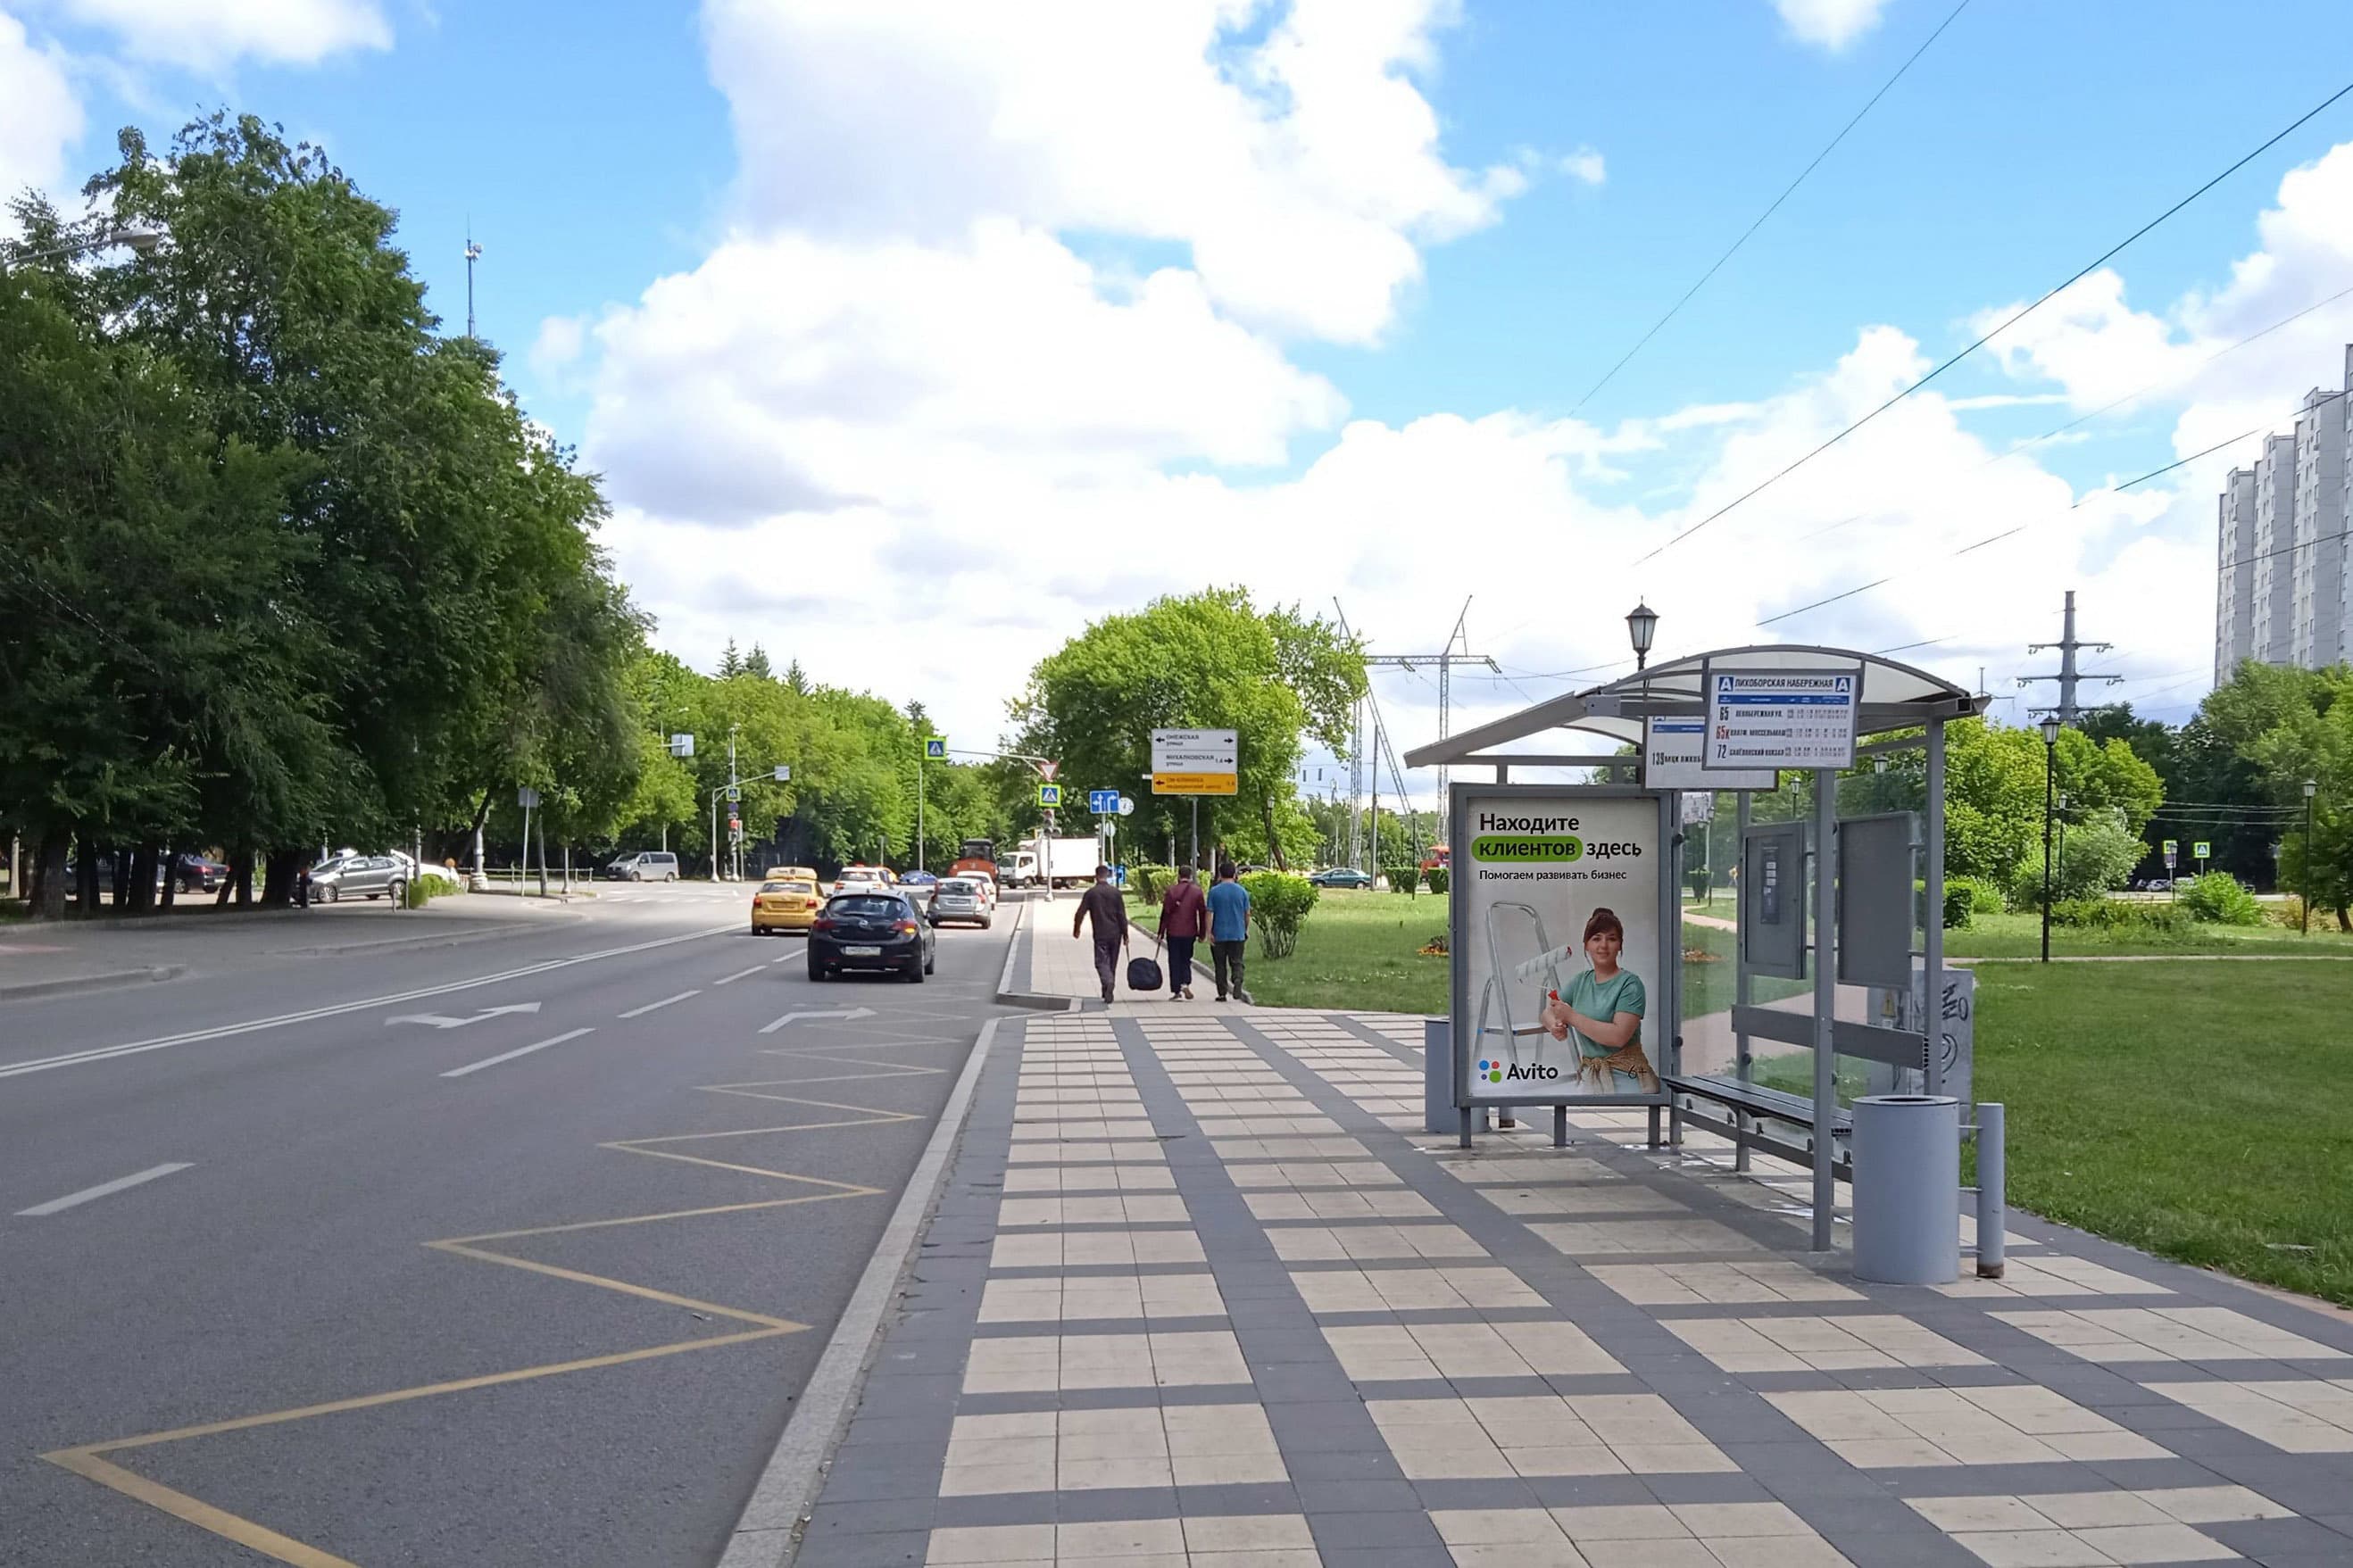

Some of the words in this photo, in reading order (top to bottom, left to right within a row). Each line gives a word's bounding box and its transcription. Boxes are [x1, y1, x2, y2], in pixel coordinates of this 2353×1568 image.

[1734, 678, 1785, 687] ЛИХОБОРСКАЯ
[1786, 678, 1833, 688] НАБЕРЕЖНАЯ
[1719, 706, 1730, 721] 65
[1717, 743, 1727, 759] 72
[1479, 813, 1580, 834] Находите
[1479, 842, 1576, 857] клиентов
[1586, 842, 1642, 859] здесь
[1479, 870, 1534, 880] Помогаем
[1536, 871, 1588, 882] развивать
[1591, 869, 1627, 880] бизнес
[1507, 1063, 1559, 1081] Avito
[1627, 1065, 1648, 1080] 6+
